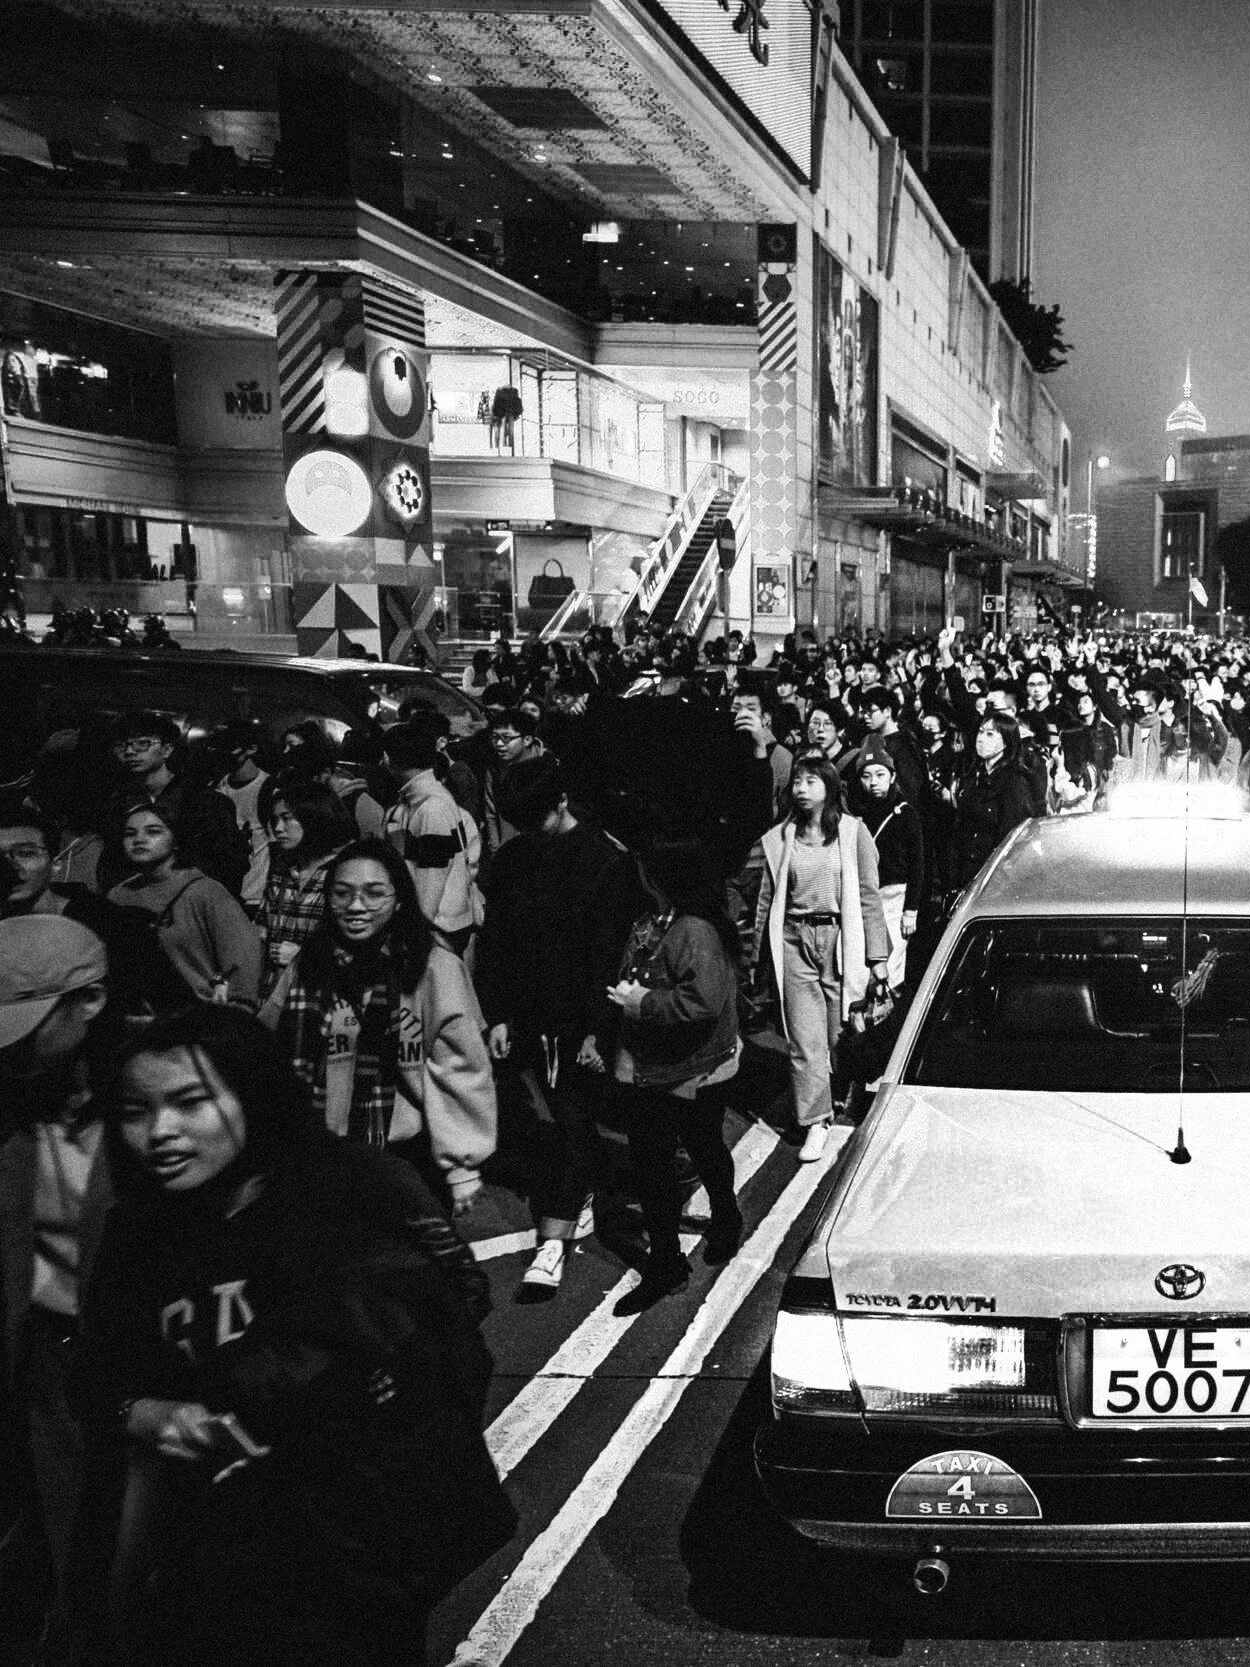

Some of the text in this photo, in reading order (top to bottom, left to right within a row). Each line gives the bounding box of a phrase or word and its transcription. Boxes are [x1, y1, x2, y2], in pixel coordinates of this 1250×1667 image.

[672, 390, 720, 404] SOGO
[846, 1293, 902, 1308] TOYOTA
[1147, 1328, 1218, 1369] VE
[930, 1456, 994, 1476] TAXI
[947, 1475, 976, 1500] 4
[918, 1502, 1010, 1515] SEATS
